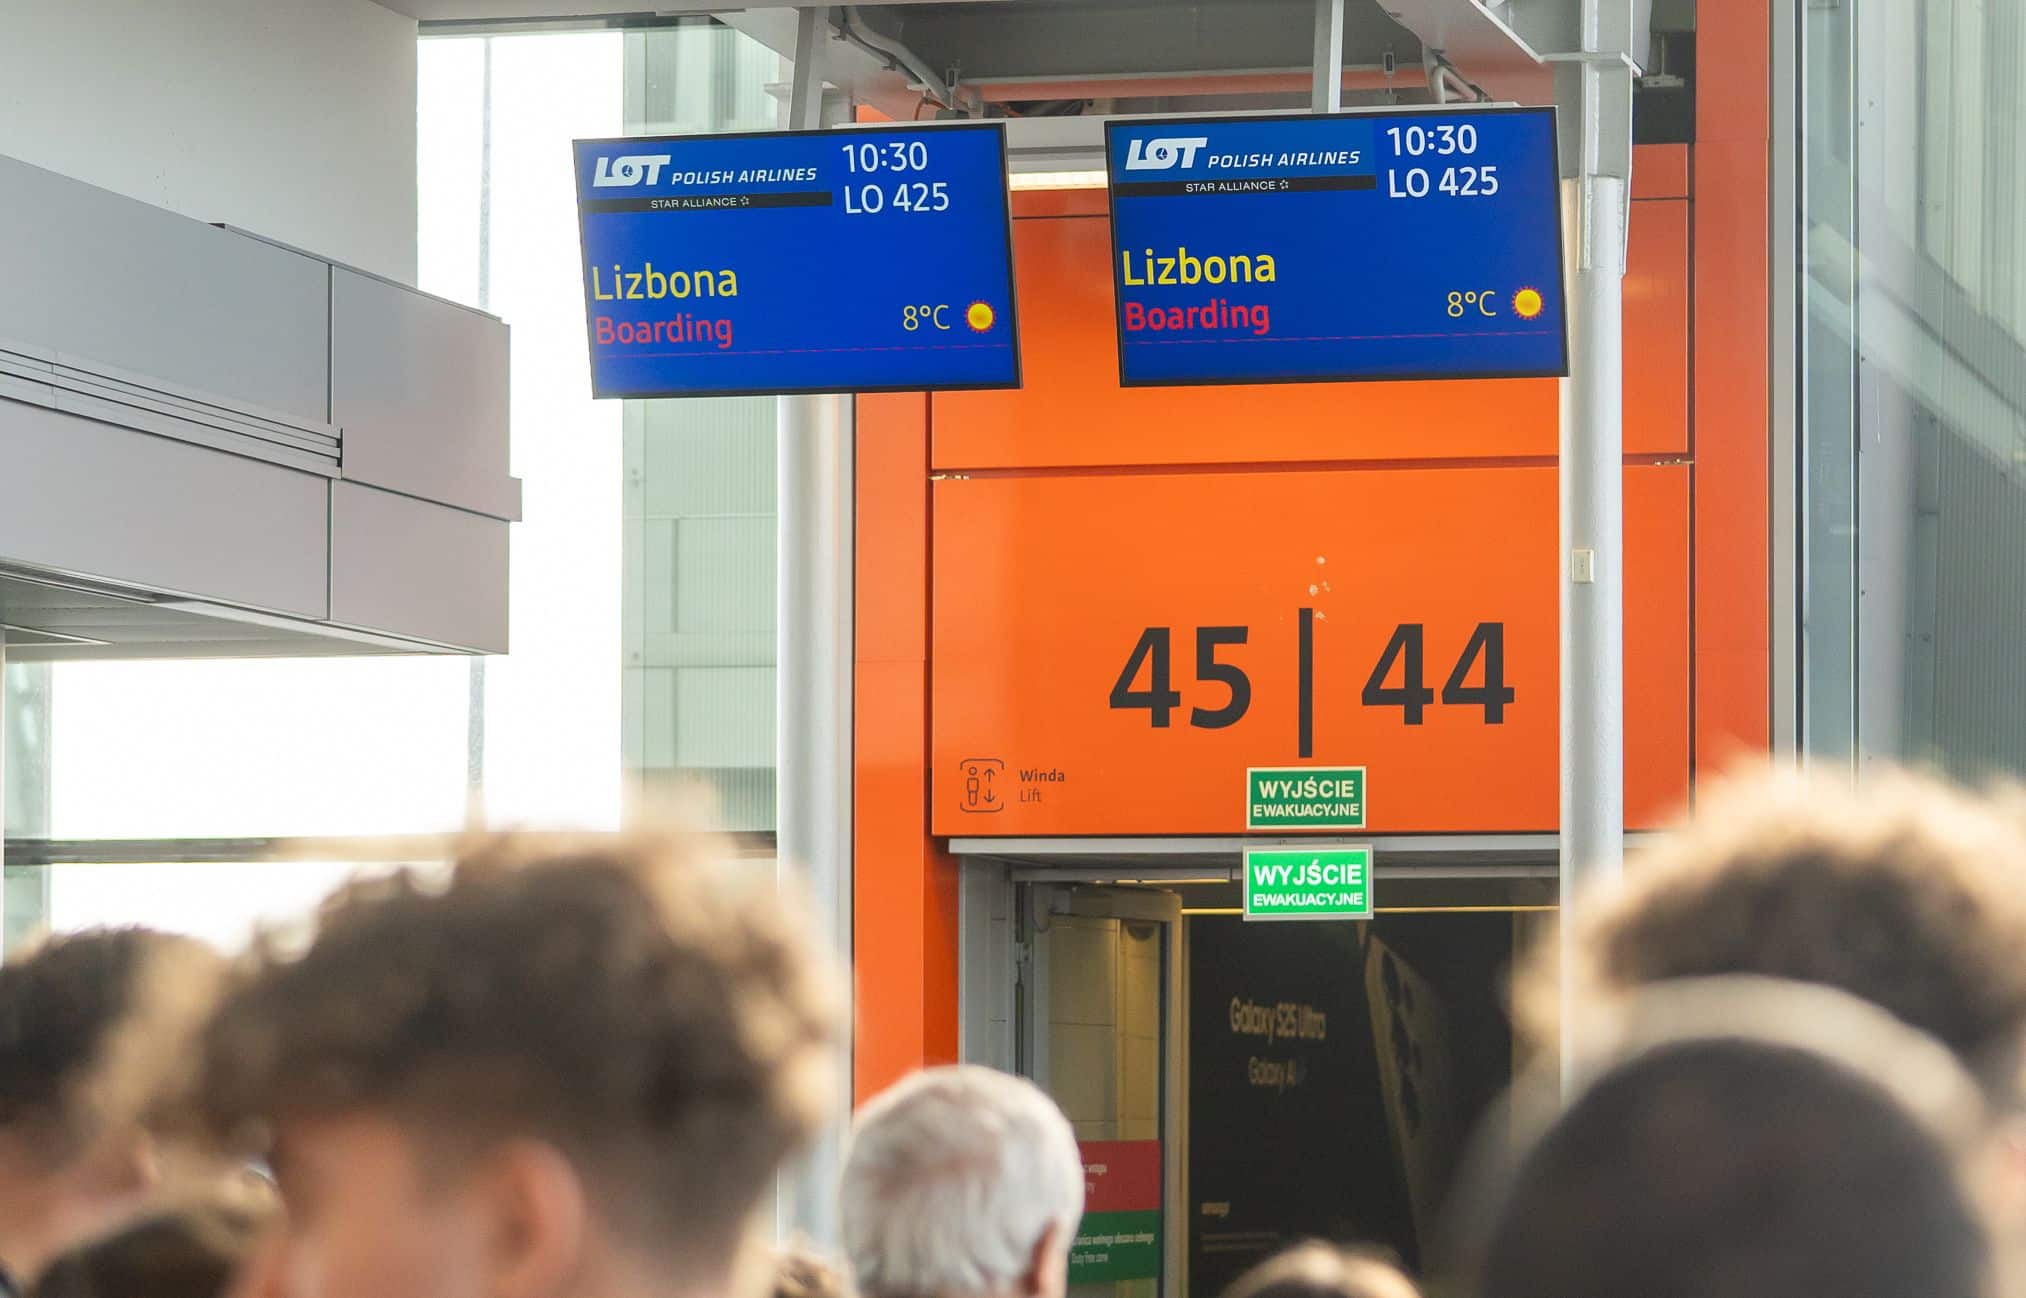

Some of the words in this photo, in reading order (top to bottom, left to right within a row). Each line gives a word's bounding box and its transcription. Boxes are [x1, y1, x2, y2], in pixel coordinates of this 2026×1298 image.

[1125, 137, 1208, 171] LOT
[1208, 153, 1273, 169] POLISH
[1277, 150, 1361, 167] AIRLINES
[1387, 124, 1477, 156] 10:30
[593, 154, 672, 188] LOT
[672, 169, 734, 186] POLISH
[738, 166, 817, 183] AIRLINES
[842, 141, 928, 173] 10:30
[844, 183, 884, 214] LO
[893, 181, 950, 213] 425
[1185, 183, 1216, 193] STAR
[1218, 180, 1276, 192] ALLIANCE
[1388, 167, 1430, 199] LO
[1438, 165, 1499, 197] 425
[650, 198, 680, 210] STAR
[682, 196, 737, 208] ALLIANCE
[592, 262, 738, 301] Lizbona
[1122, 246, 1277, 287] Lizbona
[596, 314, 733, 349] Boarding
[1125, 299, 1271, 336] Boarding
[1109, 626, 1252, 729] 45
[1361, 622, 1516, 726] 44
[1019, 768, 1066, 783] Winda
[1258, 776, 1355, 799] WYJŚCIE
[1019, 788, 1042, 803] Lift
[1252, 803, 1360, 817] EWAKUACYJNE
[1253, 859, 1363, 886] WYJŚCIE
[1252, 892, 1364, 907] EWAKUACYJNE
[1229, 996, 1275, 1044] Galaxy
[1275, 1002, 1298, 1038] S25
[1247, 1056, 1285, 1093] Galaxy
